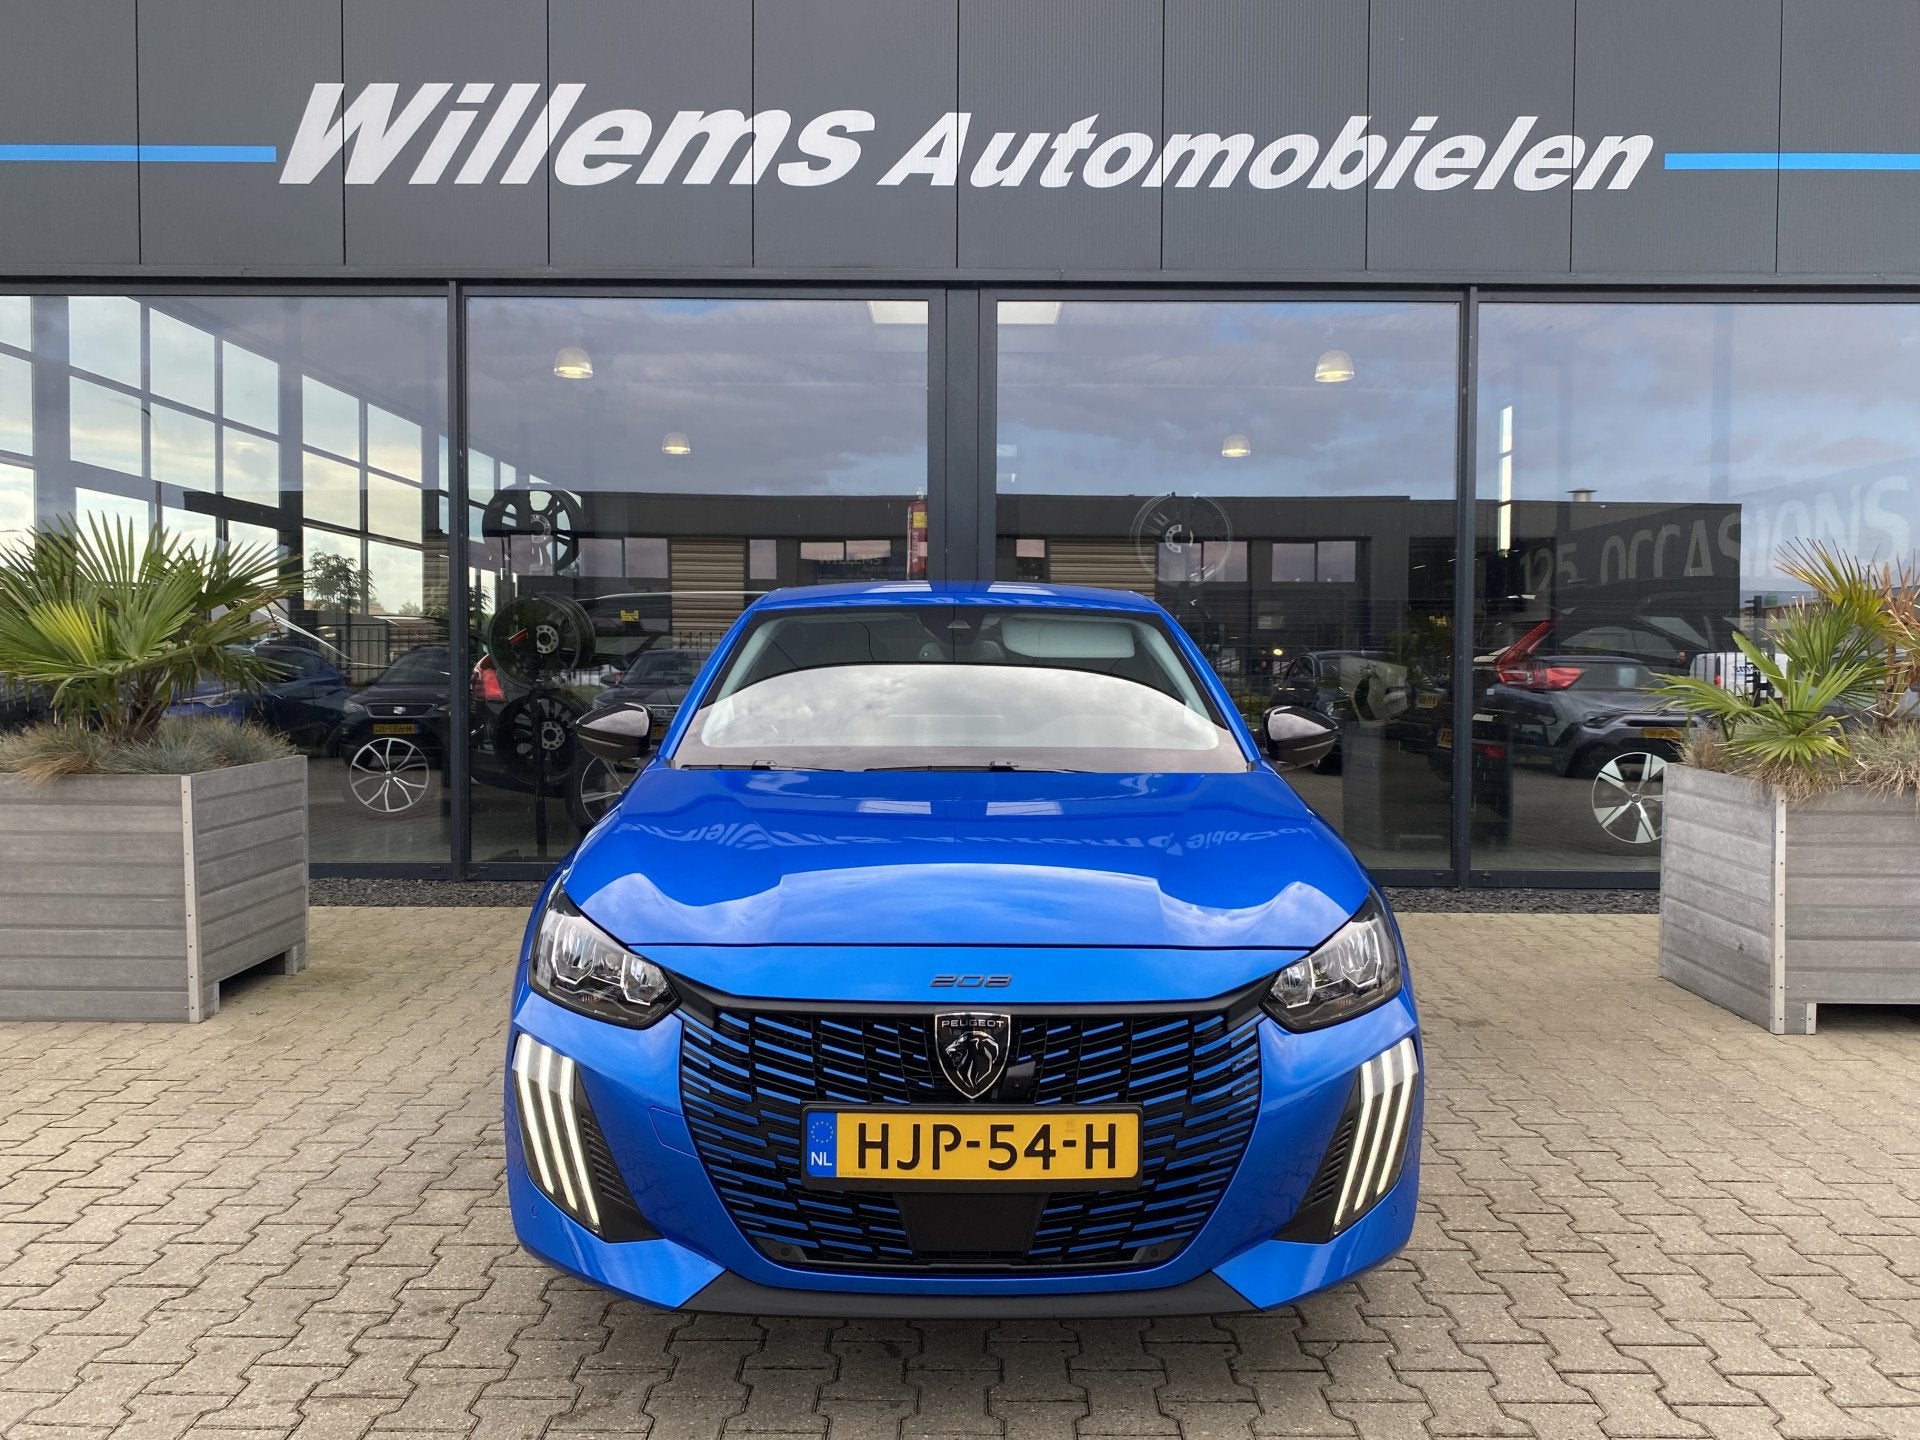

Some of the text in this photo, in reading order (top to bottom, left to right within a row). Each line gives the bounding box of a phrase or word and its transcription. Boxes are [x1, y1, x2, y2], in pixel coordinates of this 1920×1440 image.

[279, 82, 1654, 192] Willems Automobielen
[930, 974, 1012, 987] 208
[941, 1019, 1004, 1028] PEUGEOT
[857, 1122, 1117, 1171] HJP-54-H
[810, 1151, 833, 1167] NL
